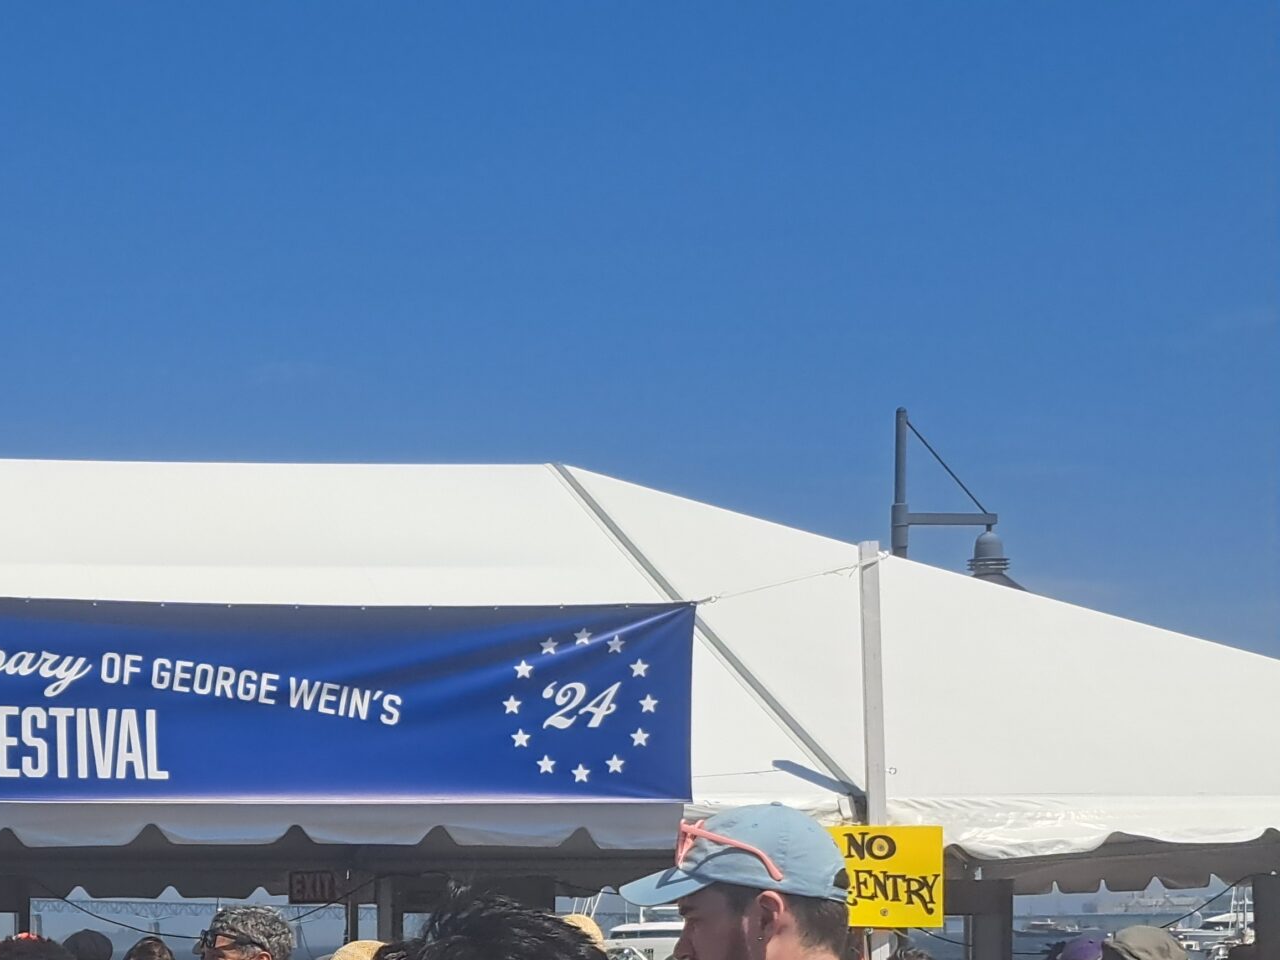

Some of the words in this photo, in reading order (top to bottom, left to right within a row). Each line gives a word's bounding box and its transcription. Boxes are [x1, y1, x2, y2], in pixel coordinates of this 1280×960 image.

[101, 653, 143, 685] OF
[151, 658, 280, 705] GEORGE
[290, 677, 402, 726] WEIN'S
[842, 831, 897, 861] NO
[847, 869, 941, 915] ENTRY
